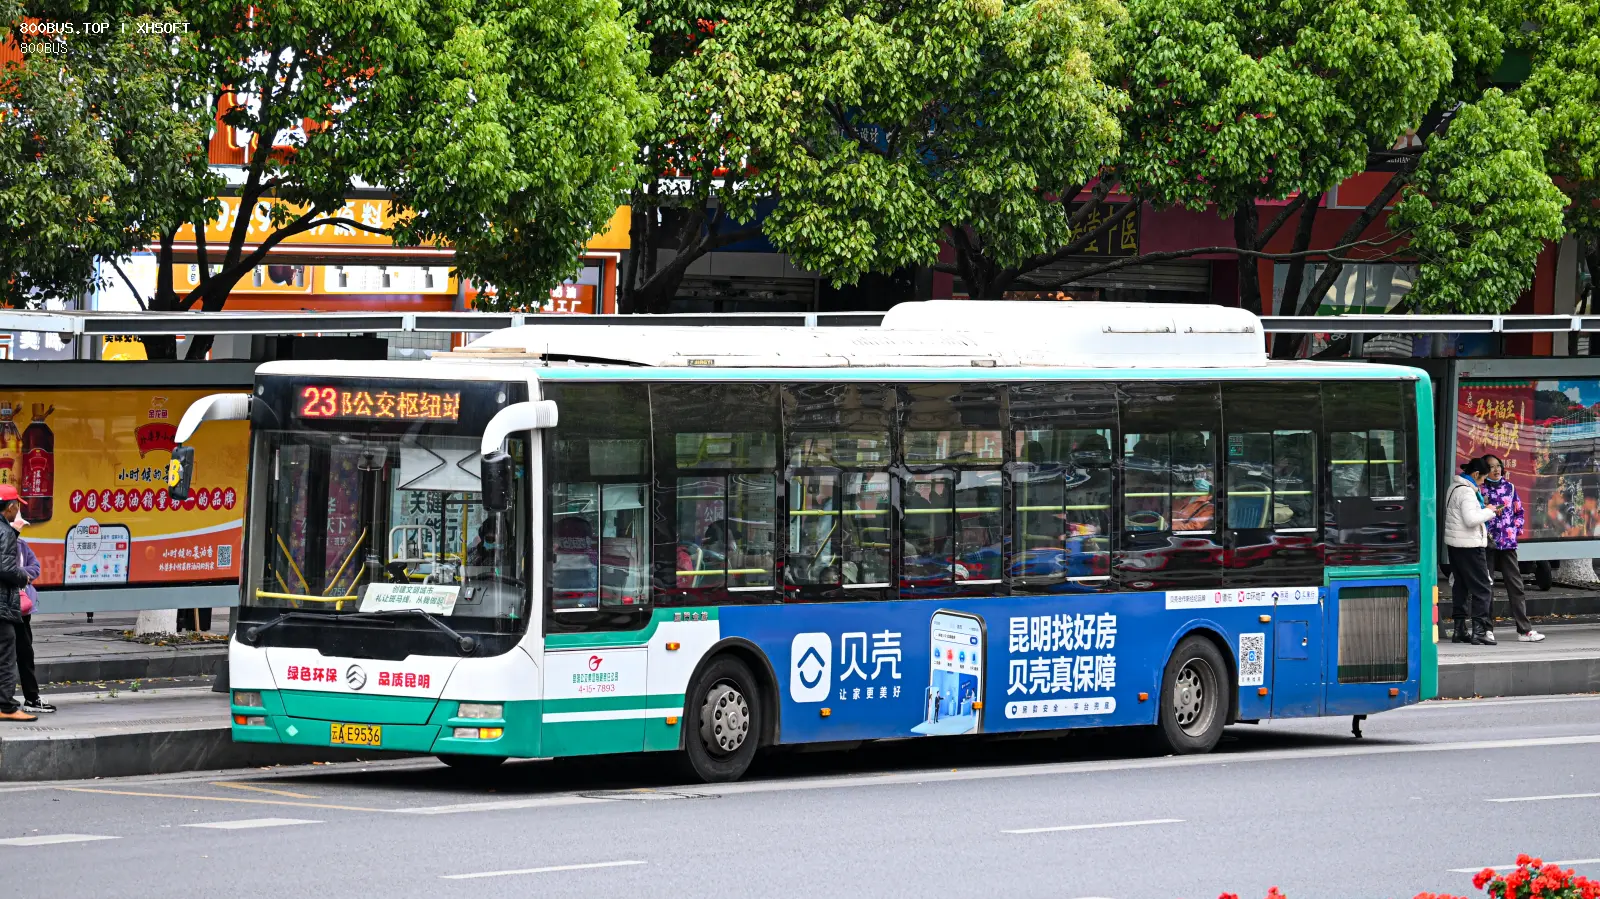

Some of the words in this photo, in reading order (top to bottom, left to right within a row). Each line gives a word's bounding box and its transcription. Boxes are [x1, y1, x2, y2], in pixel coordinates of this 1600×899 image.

[302, 386, 337, 416] 23
[1008, 612, 1118, 653] 昆明找好房
[839, 629, 902, 682] 贝壳
[287, 666, 338, 683] 绿色环保
[378, 671, 430, 689] 品质昆明
[1006, 653, 1118, 696] 贝壳真保障
[839, 685, 902, 701] 让家更美好
